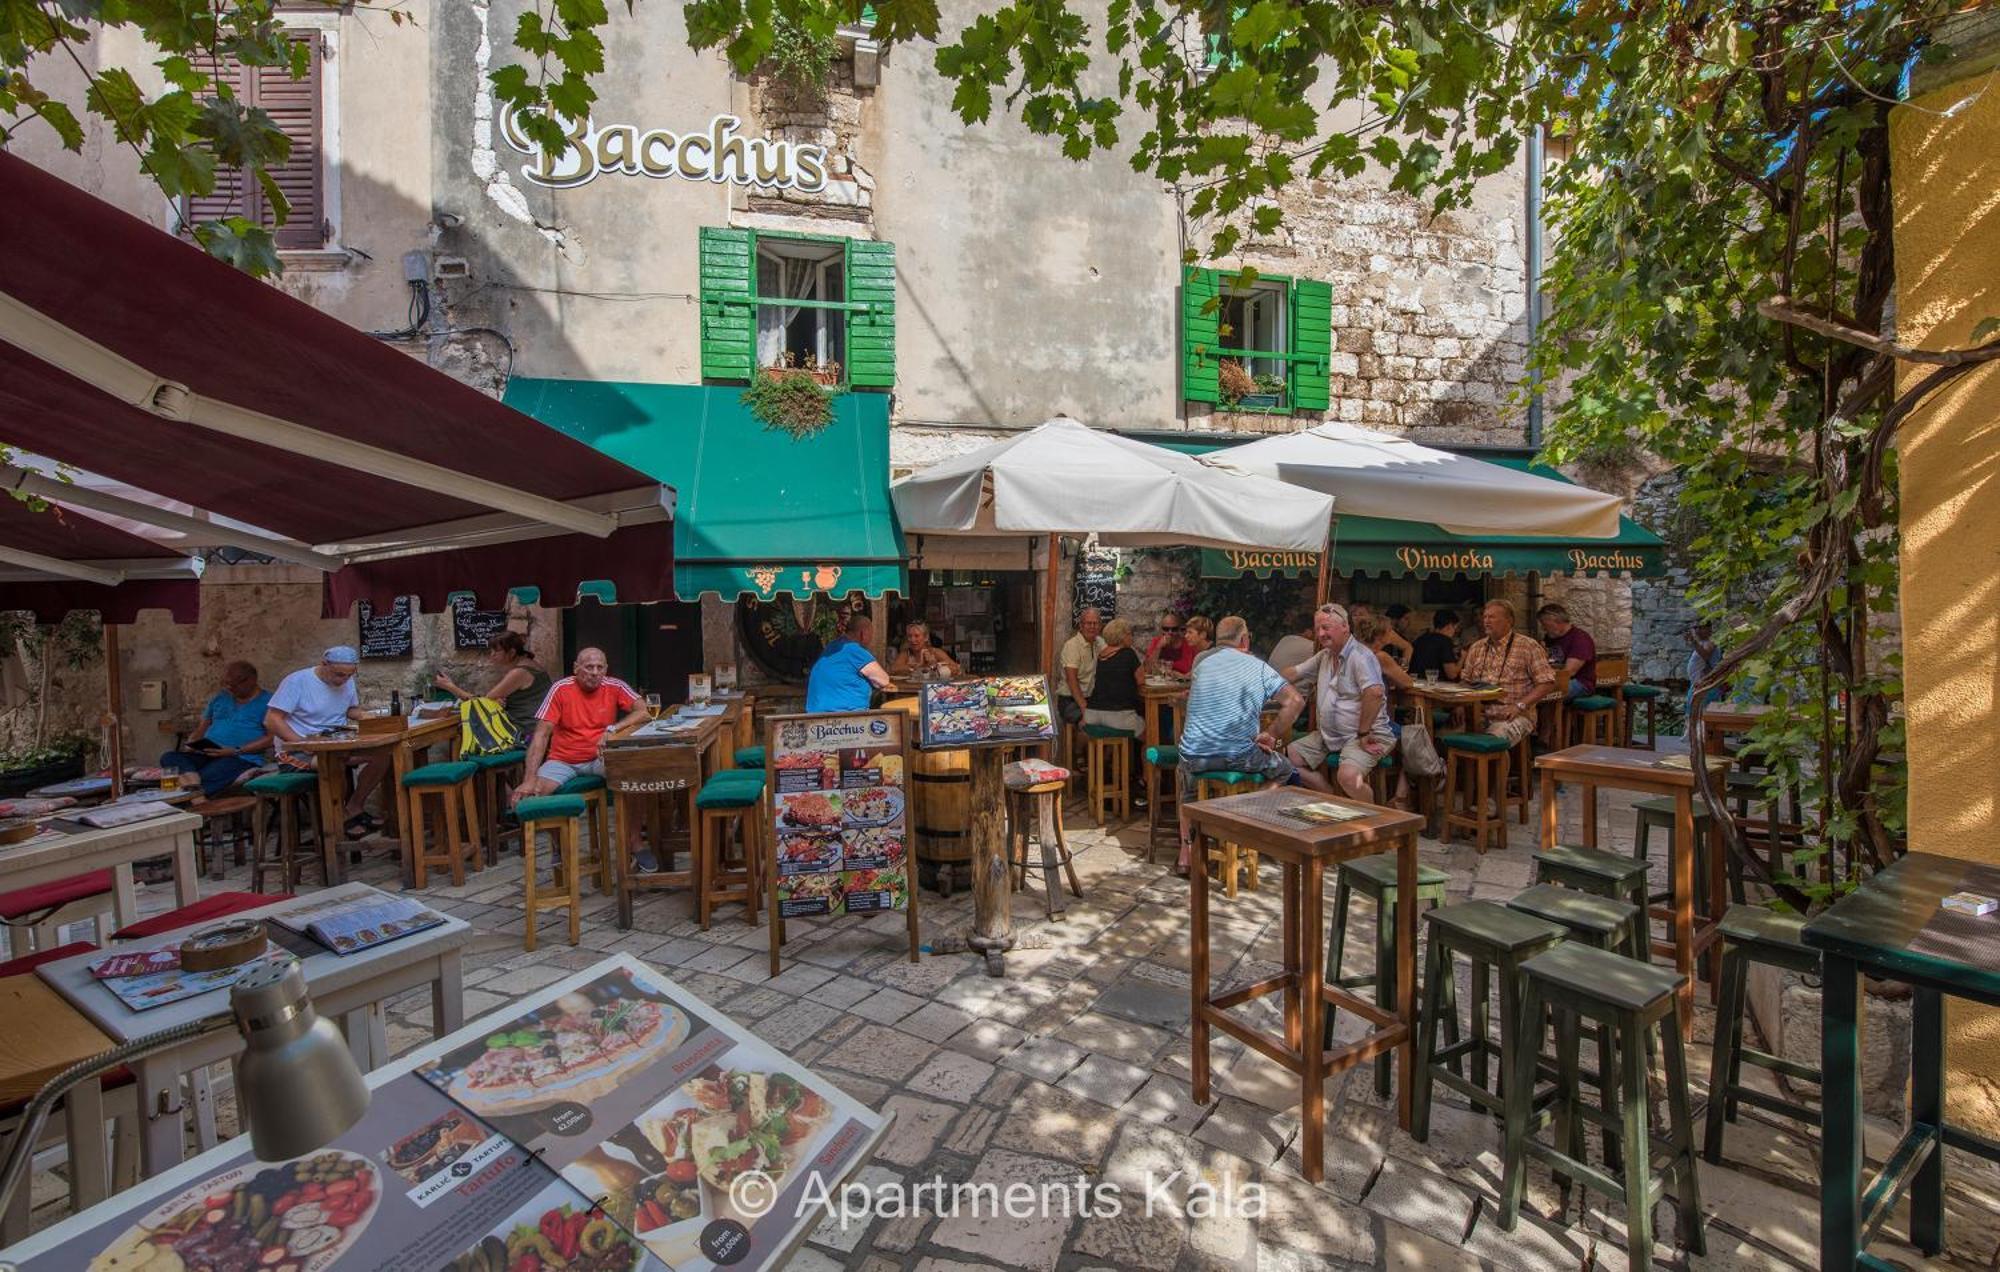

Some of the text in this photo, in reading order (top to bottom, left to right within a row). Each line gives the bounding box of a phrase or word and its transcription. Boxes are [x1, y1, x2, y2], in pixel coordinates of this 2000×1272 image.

[501, 98, 827, 192] Bacchus
[1396, 547, 1494, 571] Vinoteka
[1567, 548, 1645, 570] Bacchus
[810, 723, 865, 740] Bacchus
[620, 779, 687, 793] BACCHUS
[455, 1153, 518, 1198] Tartufo
[711, 1229, 732, 1249] from
